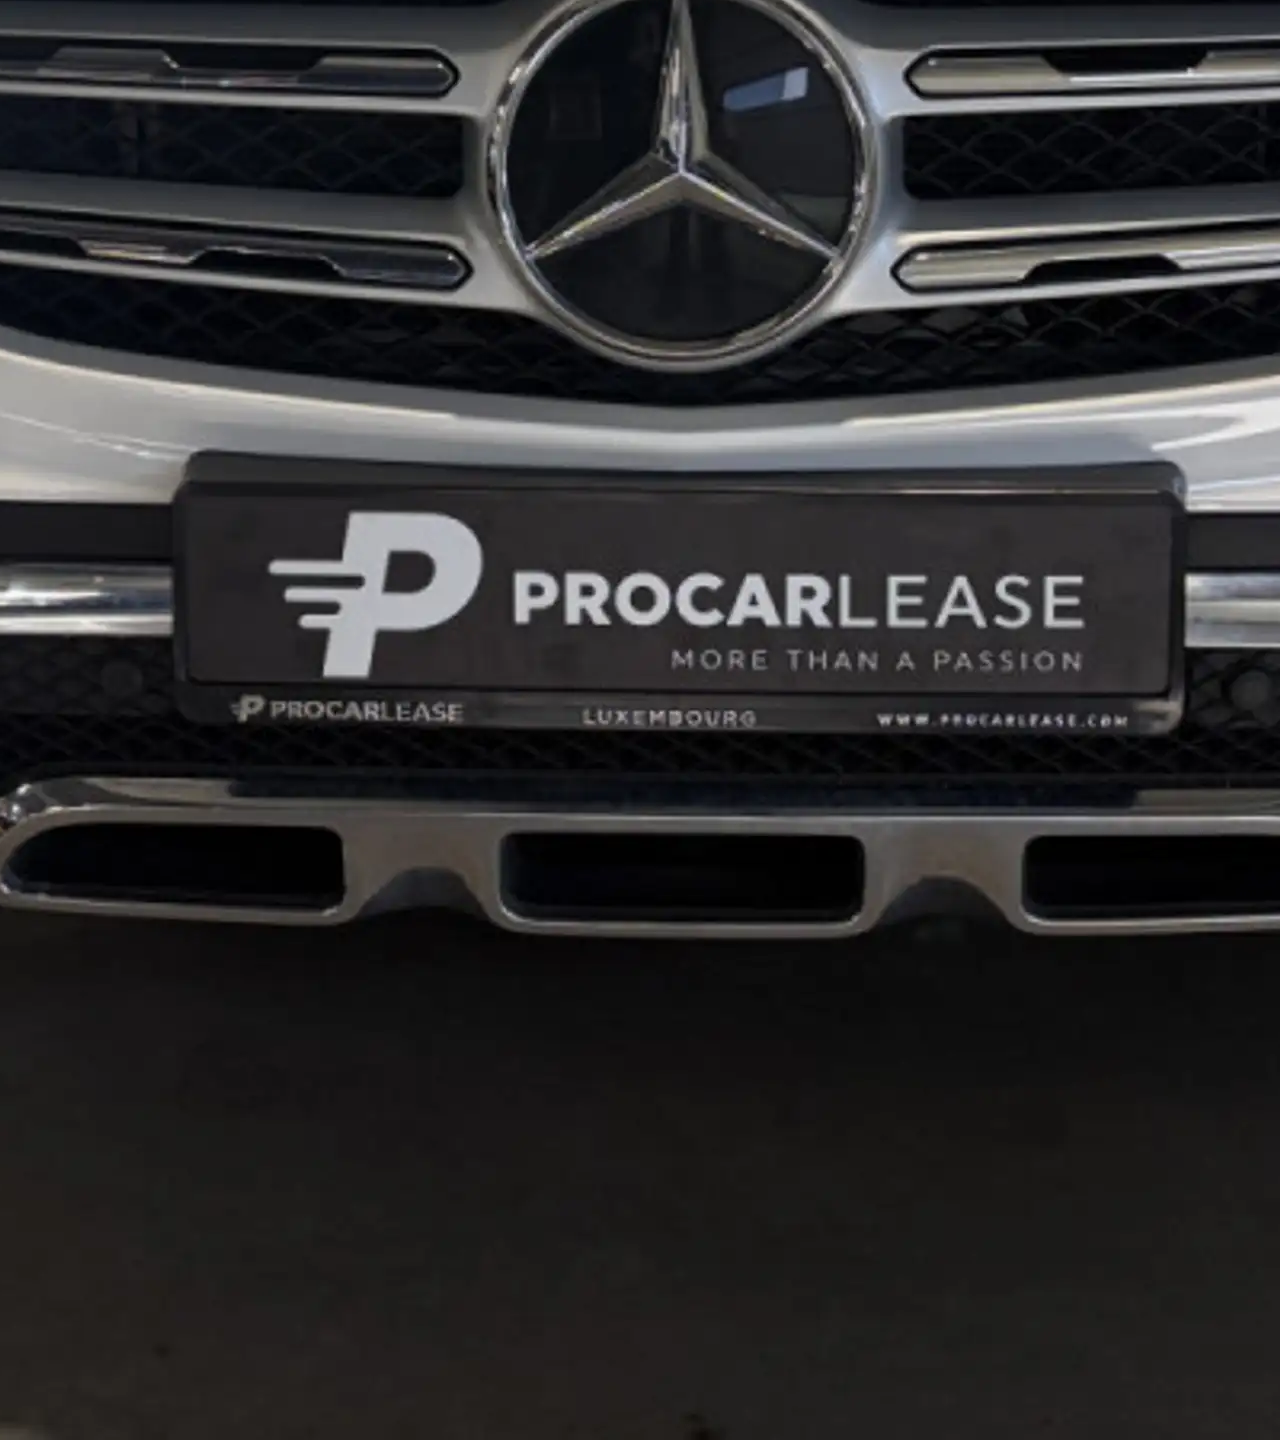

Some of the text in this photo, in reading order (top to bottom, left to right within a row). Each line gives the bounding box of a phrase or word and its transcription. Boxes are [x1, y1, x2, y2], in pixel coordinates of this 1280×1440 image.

[513, 571, 1086, 629] PROCARLEASE
[671, 648, 1083, 673] MORE THAN A PASSION
[270, 699, 465, 724] PROCARLEASE
[582, 708, 758, 728] LUXEMBOURG
